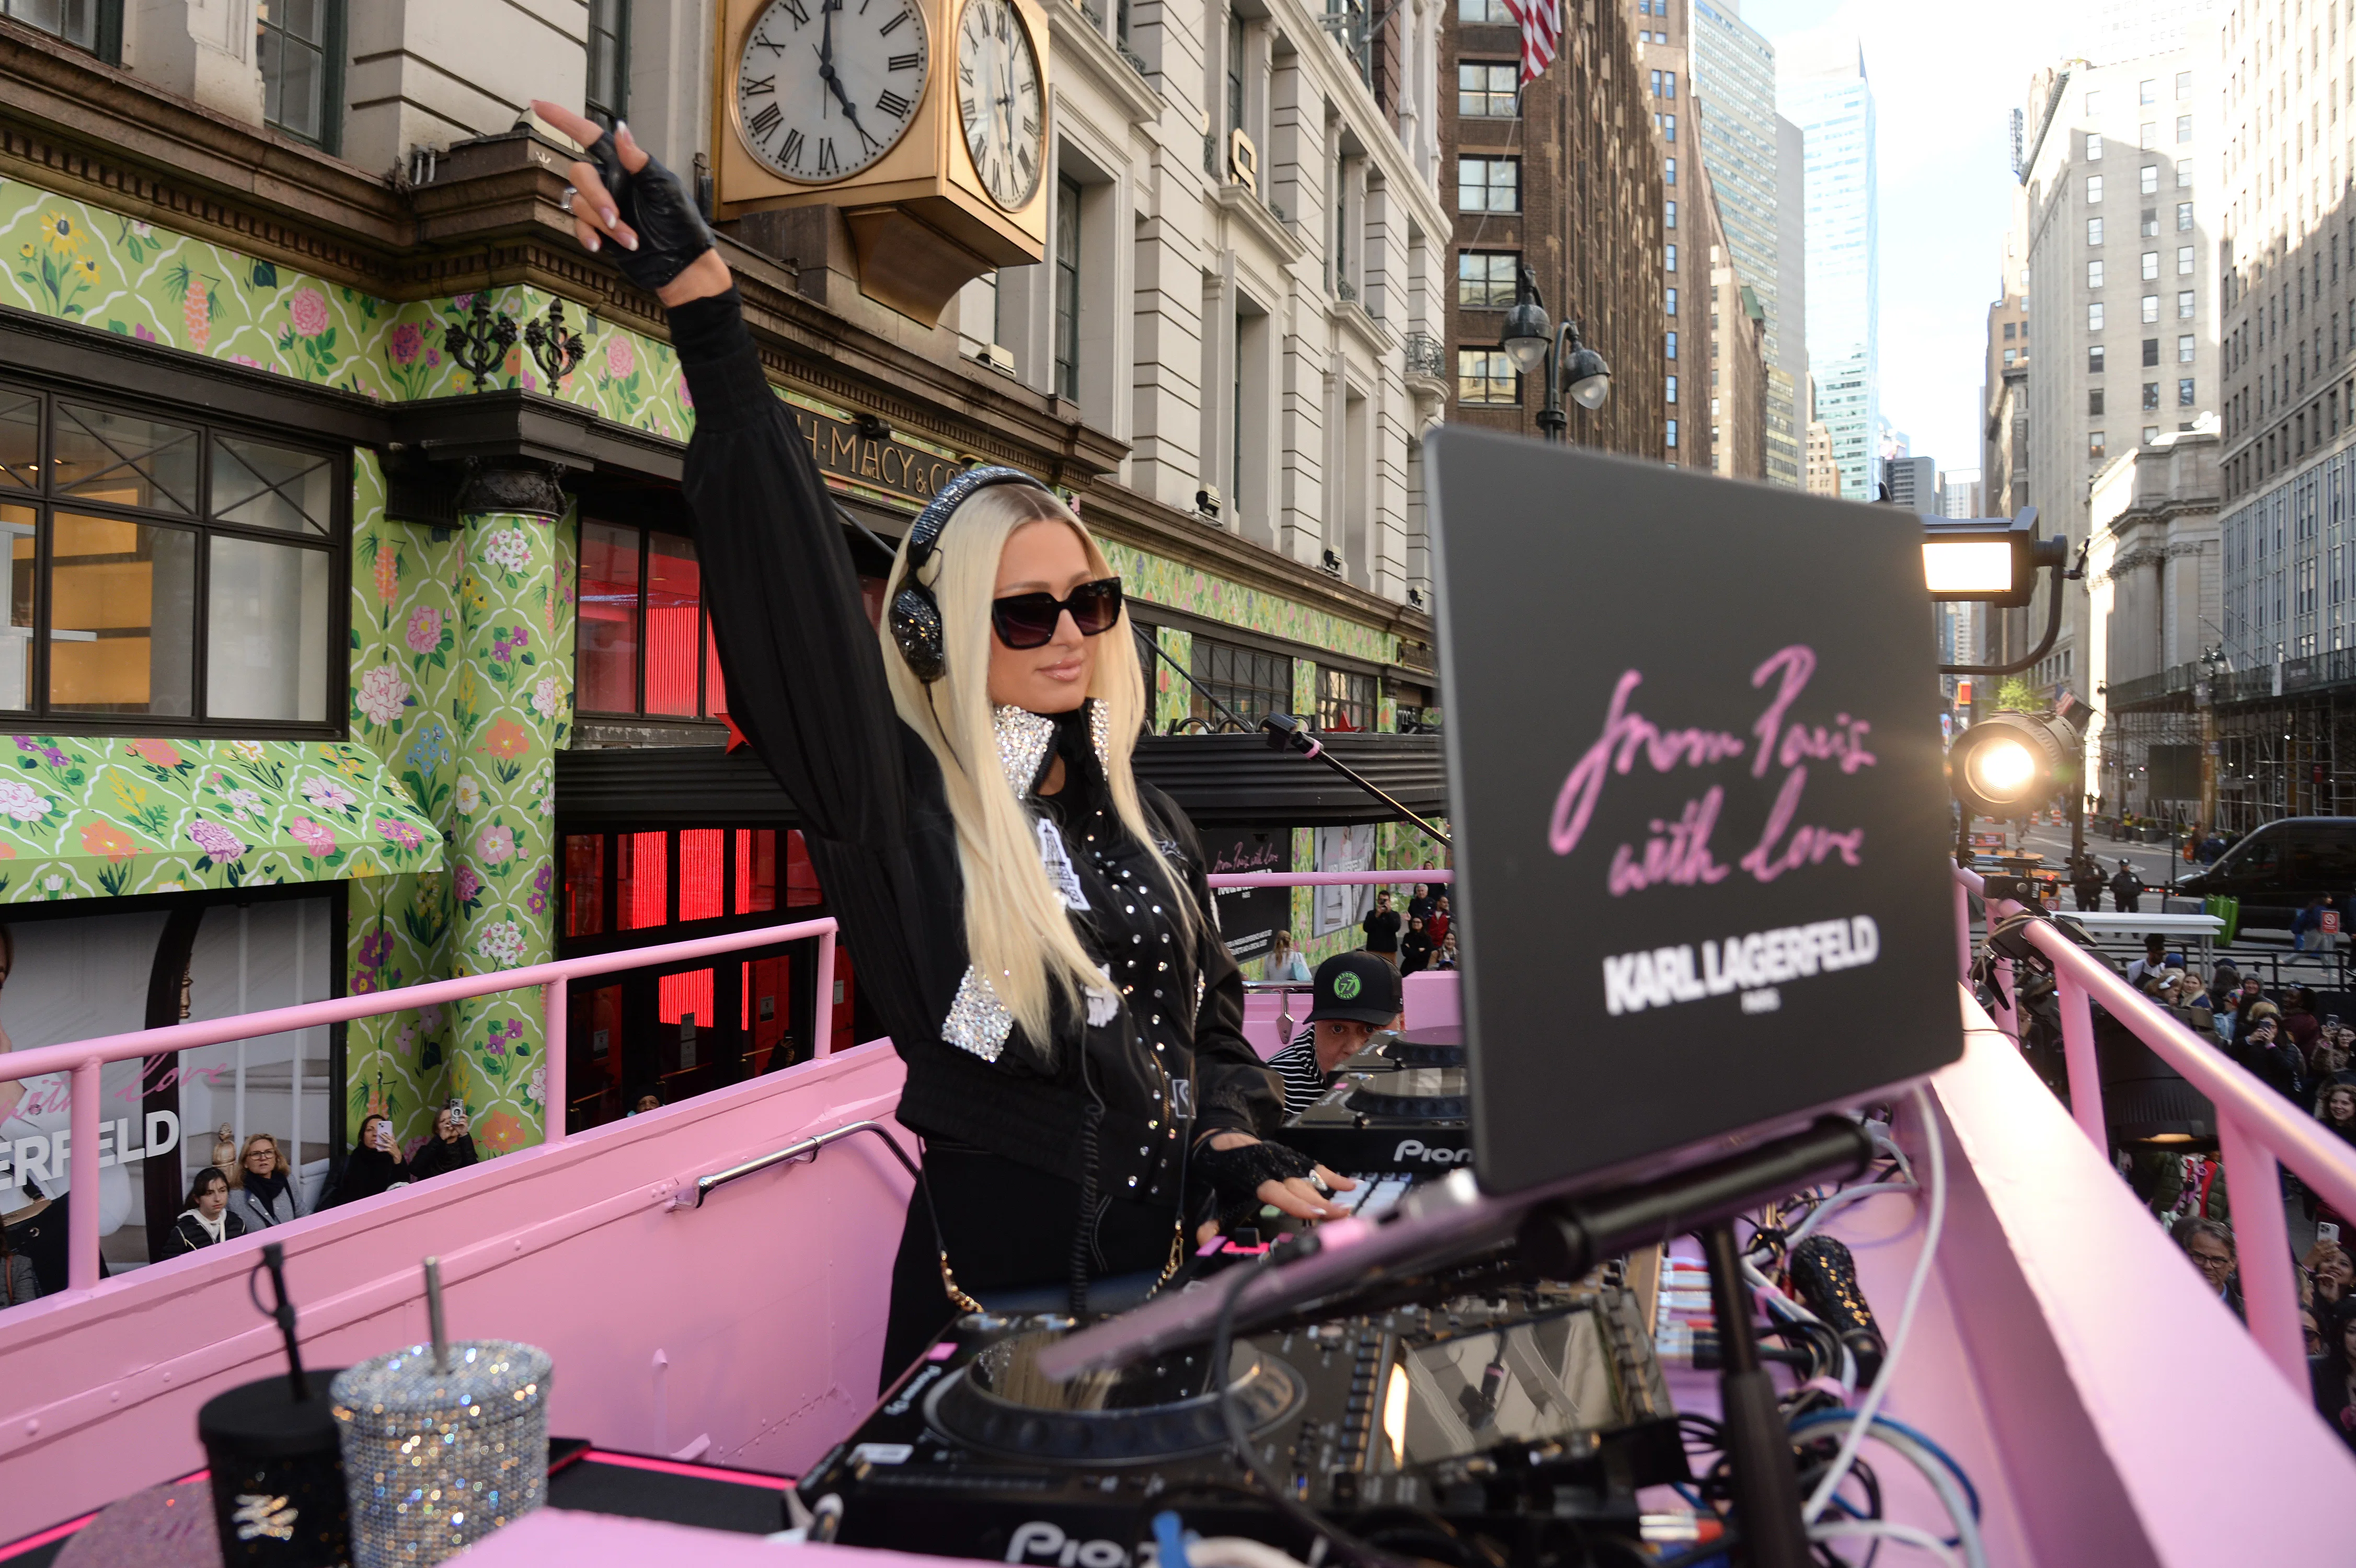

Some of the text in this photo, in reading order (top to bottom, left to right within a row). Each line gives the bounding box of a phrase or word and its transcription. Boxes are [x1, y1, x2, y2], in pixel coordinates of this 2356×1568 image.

[756, 32, 786, 58] X
[889, 52, 918, 73] III
[746, 74, 775, 96] IX
[818, 137, 838, 171] VI
[915, 468, 927, 494] &
[1549, 644, 1878, 856] from Paris
[1608, 764, 1865, 897] with love
[1603, 915, 1881, 1016] KARL LAGERFELD
[0, 1052, 227, 1126] wit love
